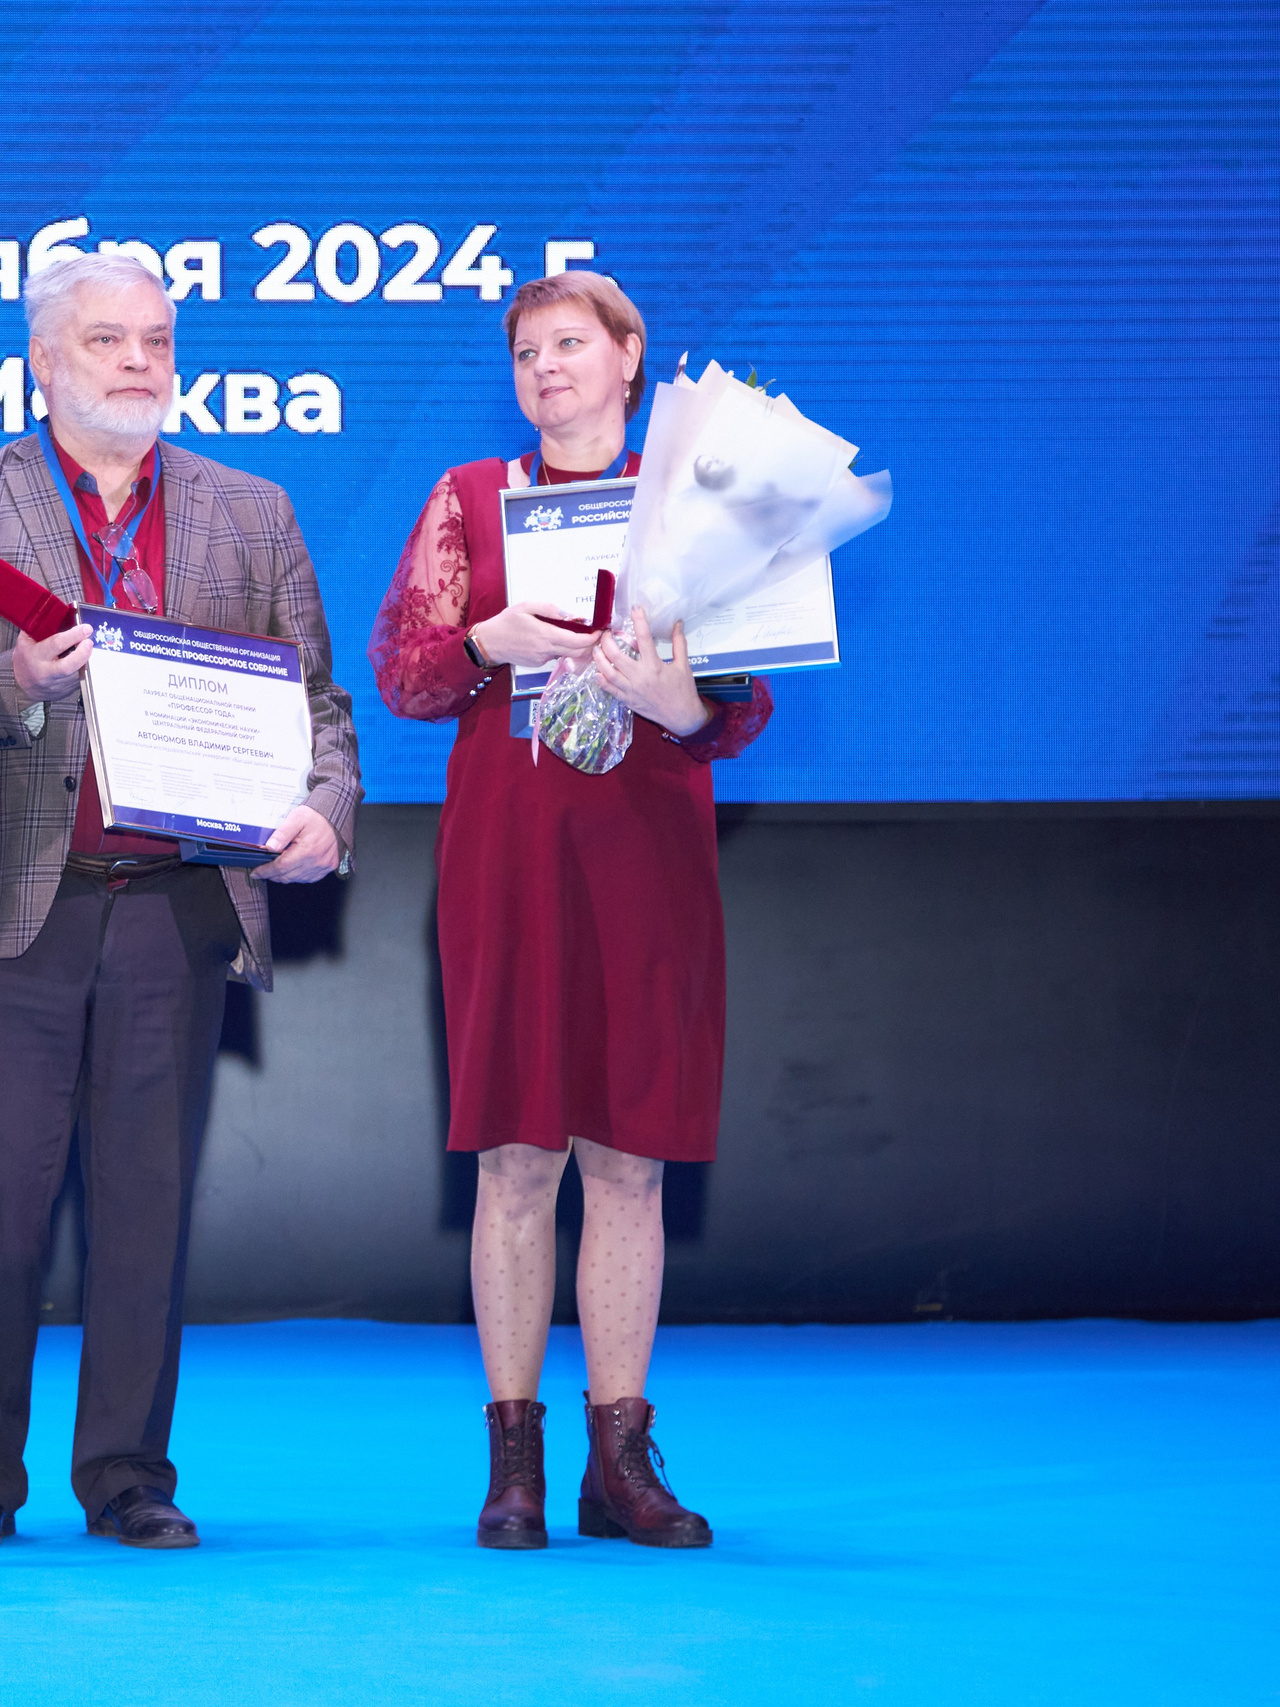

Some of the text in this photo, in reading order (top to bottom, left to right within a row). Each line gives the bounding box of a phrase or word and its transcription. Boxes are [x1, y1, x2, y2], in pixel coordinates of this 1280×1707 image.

[251, 223, 513, 301] 2024
[585, 553, 620, 561] ЛАУРЕАТ
[133, 629, 281, 661] ОБЩЕРОССИЙСКАЯ ОБЩЕСТВЕННАЯ ОРГАНИЗАЦИЯ
[130, 641, 288, 675] РОССИЙСКОЕ ПРОФЕССОРСКОЕ СОБРАНИЕ
[167, 673, 228, 695] ДИПЛОМ
[143, 689, 167, 697] ЛАУРЕАТ
[169, 693, 232, 708] ОБЩЕНАЦИОНАЛЬНОЙ
[167, 702, 235, 718] «ПРОФЕССОР ГОДА»
[152, 719, 194, 730] ЦЕНТРАЛЬНЫЙ
[196, 726, 237, 737] ФЕДЕРАЛЬНЫЙ
[137, 731, 274, 758] АВТОНОМОВ ВЛАДИМИР СЕРГЕЕВИЧ
[196, 819, 241, 831] Москва, 2024
